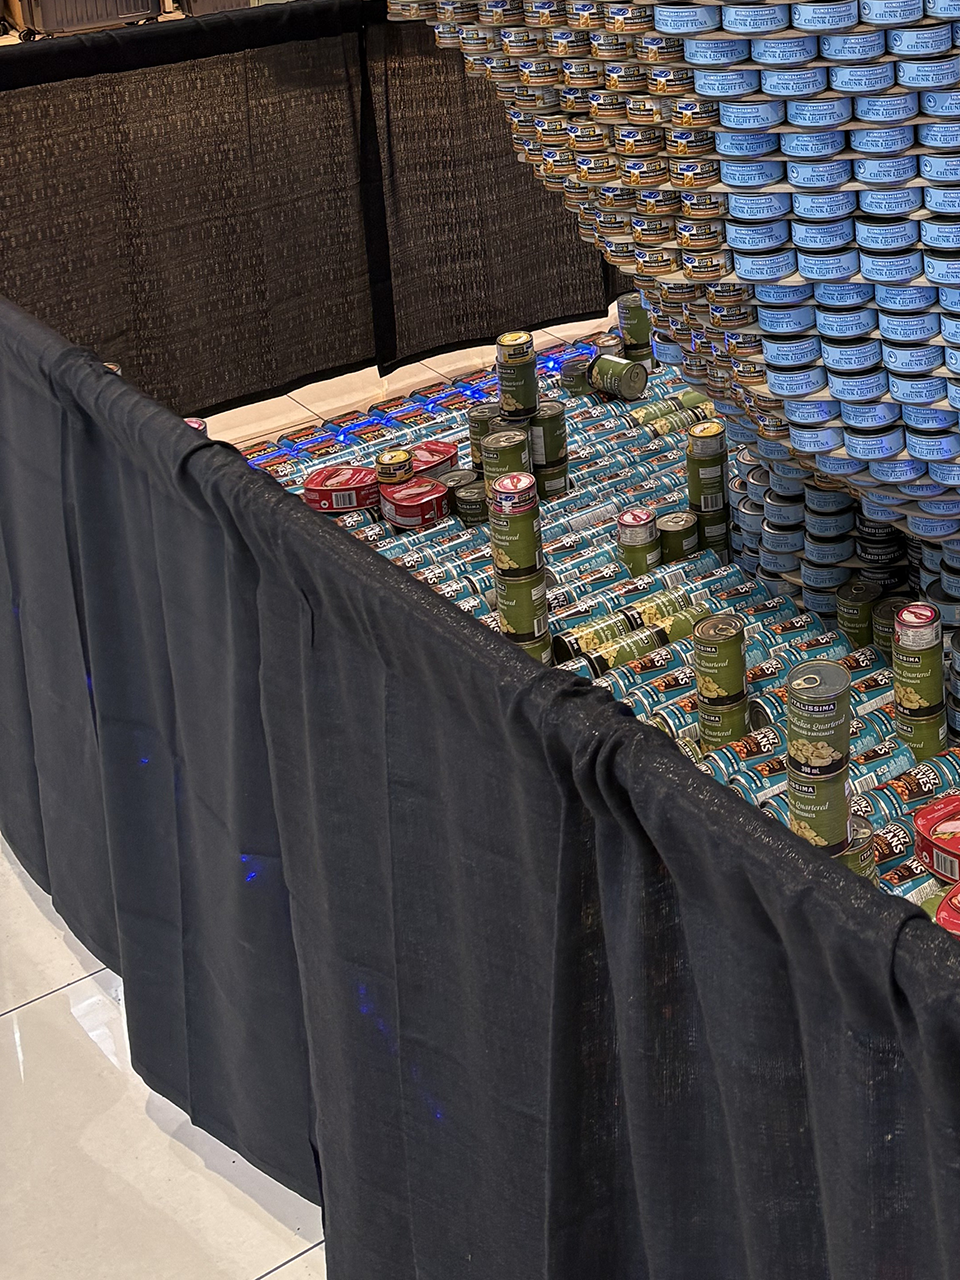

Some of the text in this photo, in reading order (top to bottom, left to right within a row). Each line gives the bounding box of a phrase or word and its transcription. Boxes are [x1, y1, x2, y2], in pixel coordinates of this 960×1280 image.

[906, 768, 933, 792] FEVES
[918, 763, 939, 788] HEINZ
[885, 823, 909, 845] HEINZ
